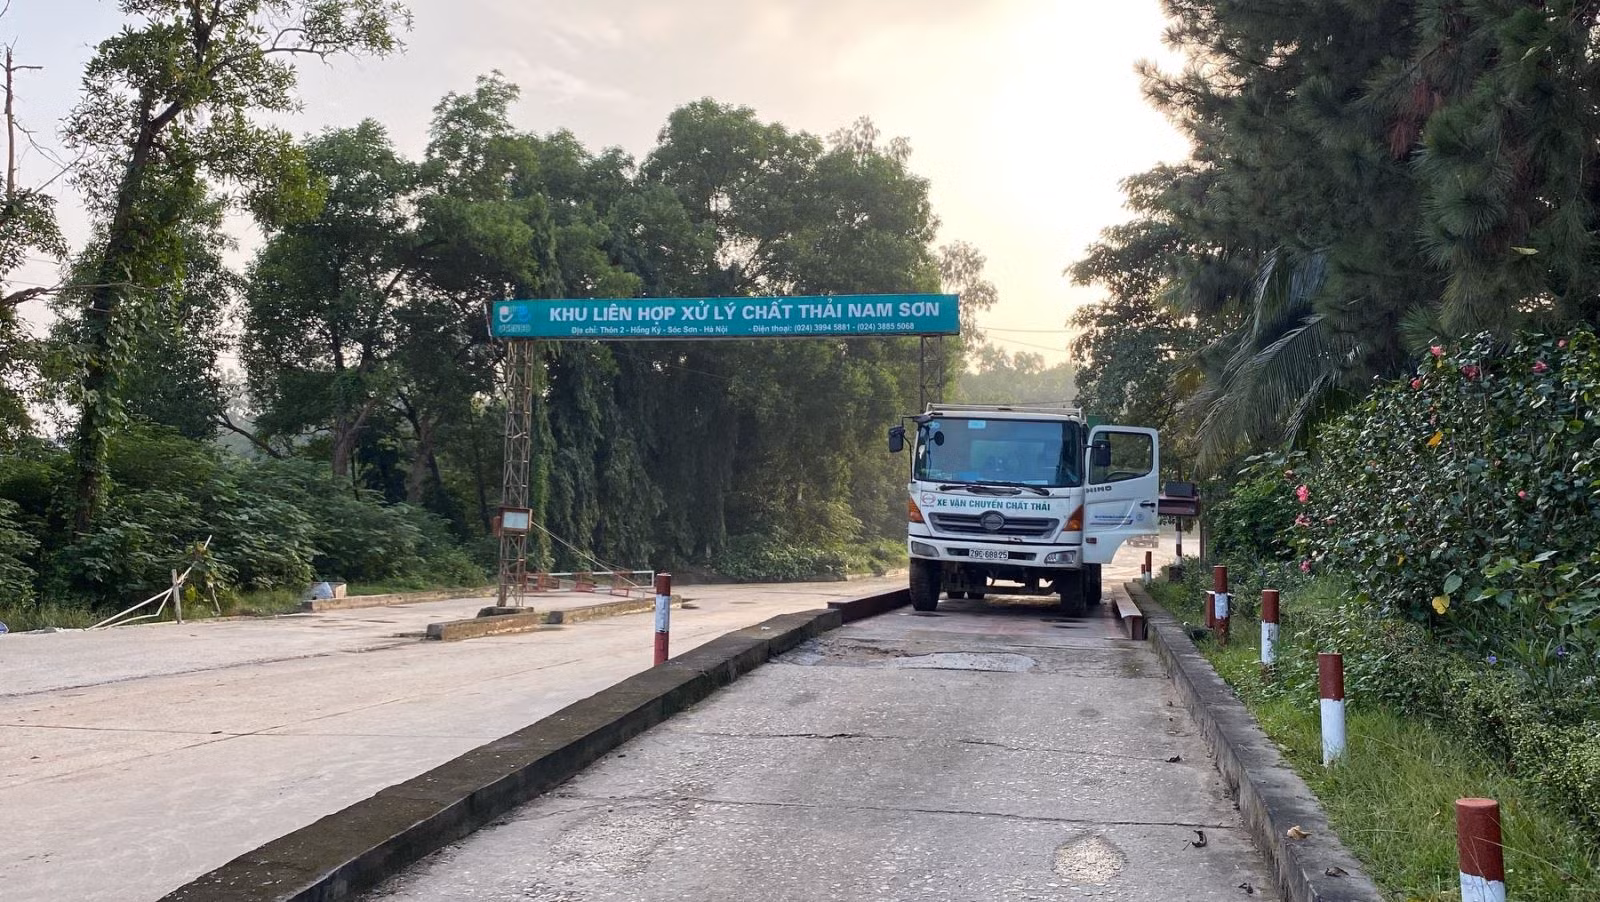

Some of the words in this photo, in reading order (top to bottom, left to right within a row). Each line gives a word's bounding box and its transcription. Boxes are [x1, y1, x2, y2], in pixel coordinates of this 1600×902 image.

[549, 307, 588, 322] KHU
[593, 303, 632, 321] LIÊN
[638, 305, 676, 325] HỢP
[680, 300, 711, 320] XỬ
[714, 302, 737, 320] LÝ
[742, 299, 793, 320] CHẤT
[798, 298, 842, 319] THẢI
[848, 303, 893, 318] NAM
[899, 301, 940, 317] SƠN
[571, 326, 584, 336] Địa
[600, 326, 618, 334] Thôn
[620, 326, 625, 334] 2
[667, 325, 681, 333] Sóc
[683, 325, 697, 333] Sơn
[703, 325, 714, 333] Hà
[715, 325, 728, 334] Nội
[752, 325, 769, 334] Điện
[771, 325, 793, 334] thoại:
[794, 324, 813, 333] (024)
[857, 323, 876, 332] (024)
[896, 322, 915, 330] 5068
[937, 498, 947, 507] XE
[950, 498, 966, 508] VẬN
[969, 497, 1003, 509] CHUYỂN
[1006, 499, 1027, 510] CHẤT
[1030, 501, 1051, 511] THẢI
